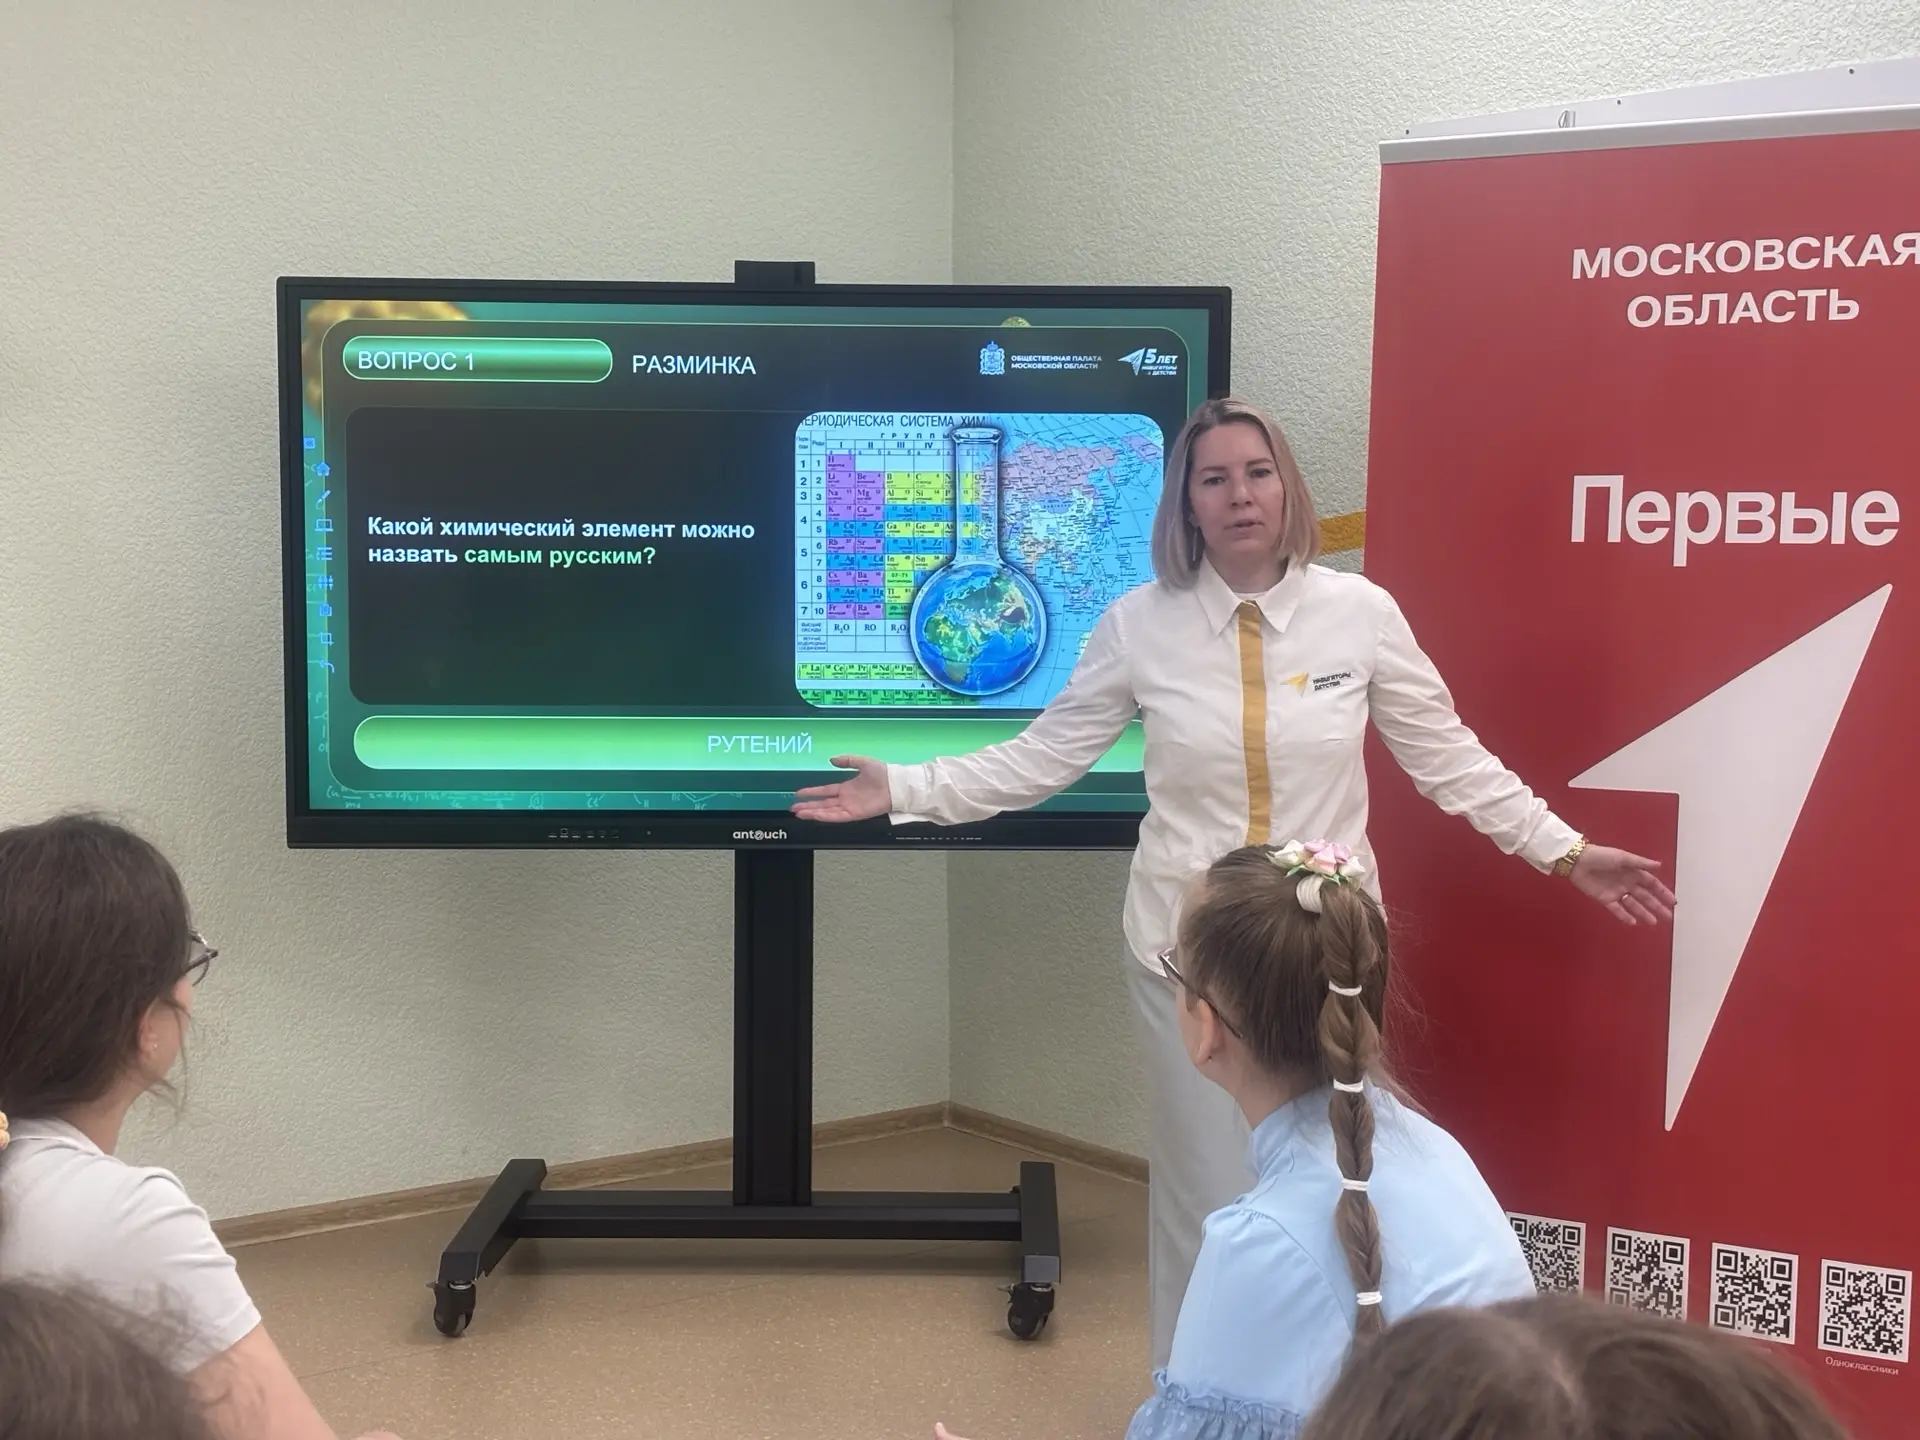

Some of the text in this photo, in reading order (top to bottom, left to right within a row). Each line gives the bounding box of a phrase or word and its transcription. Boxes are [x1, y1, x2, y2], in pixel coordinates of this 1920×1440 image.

[1571, 231, 1920, 280] МОСКОВСКАЯ
[1626, 288, 1860, 328] ОБЛАСТЬ
[1144, 348, 1178, 364] 5 ЛЕТ
[358, 351, 475, 372] ВОПРОС 1
[632, 354, 756, 375] РАЗМИНКА
[1011, 362, 1099, 370] МОСКОВСКОЙ ОБЛАСТИ
[900, 415, 955, 428] СИСТЕМА
[800, 459, 806, 468] 1
[800, 477, 807, 486] 2
[800, 491, 807, 500] 3
[816, 493, 822, 501] 3
[800, 516, 807, 524] 4
[1570, 474, 1900, 567] Первые
[368, 516, 755, 540] Какой химический элемент можно
[816, 525, 822, 533] 5
[368, 546, 656, 568] назвать самым русским?
[800, 548, 808, 557] 5
[816, 575, 822, 583] 8
[801, 580, 808, 589] 6
[801, 606, 808, 615] 7
[814, 607, 824, 615] 10
[707, 732, 812, 753] РУТЕНИЙ
[733, 829, 787, 840] antouch
[1825, 1356, 1899, 1375] Одноклассники
